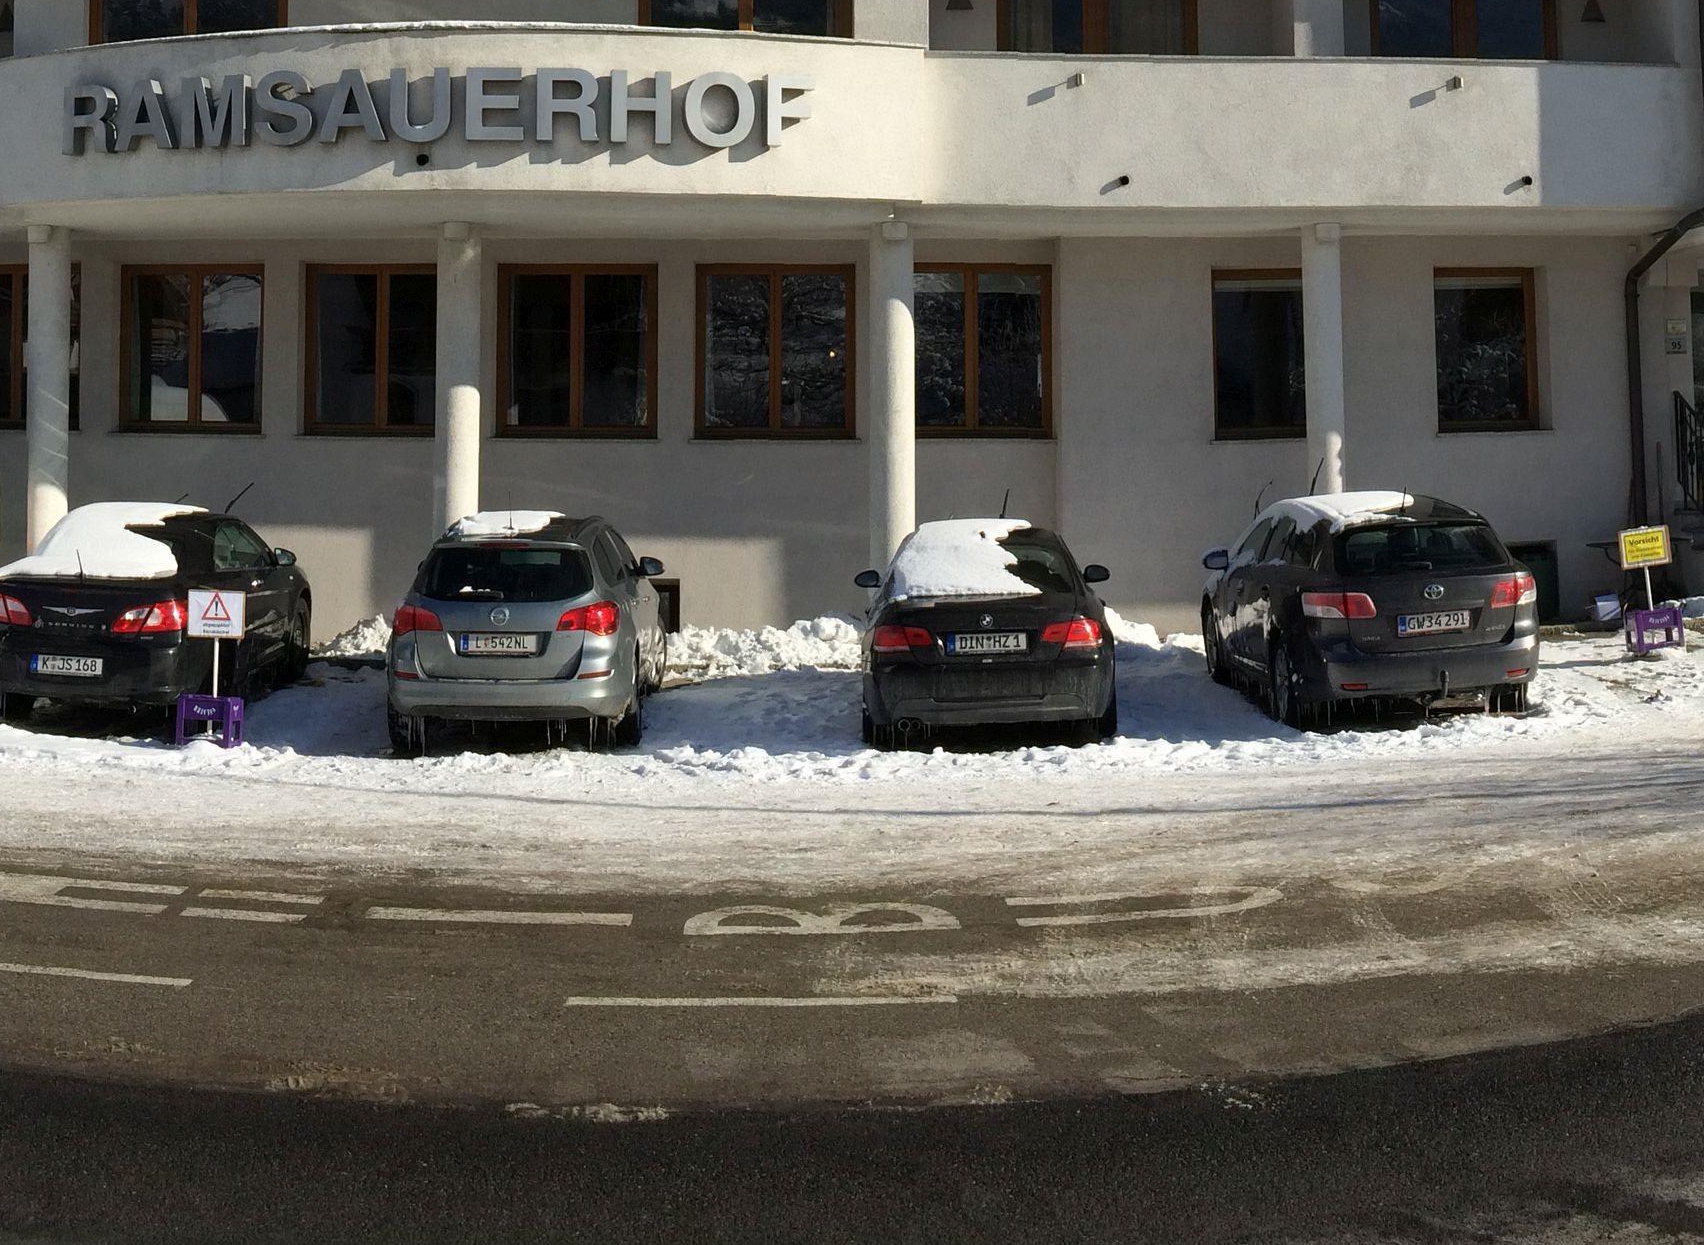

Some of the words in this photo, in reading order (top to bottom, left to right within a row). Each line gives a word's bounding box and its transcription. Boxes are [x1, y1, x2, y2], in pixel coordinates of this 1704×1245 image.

[62, 66, 815, 155] RAMSAUERHOF
[1671, 341, 1682, 350] 95
[1629, 536, 1660, 546] Vorsicht
[959, 636, 985, 650] DIN
[41, 656, 50, 670] K
[75, 658, 98, 673] 168
